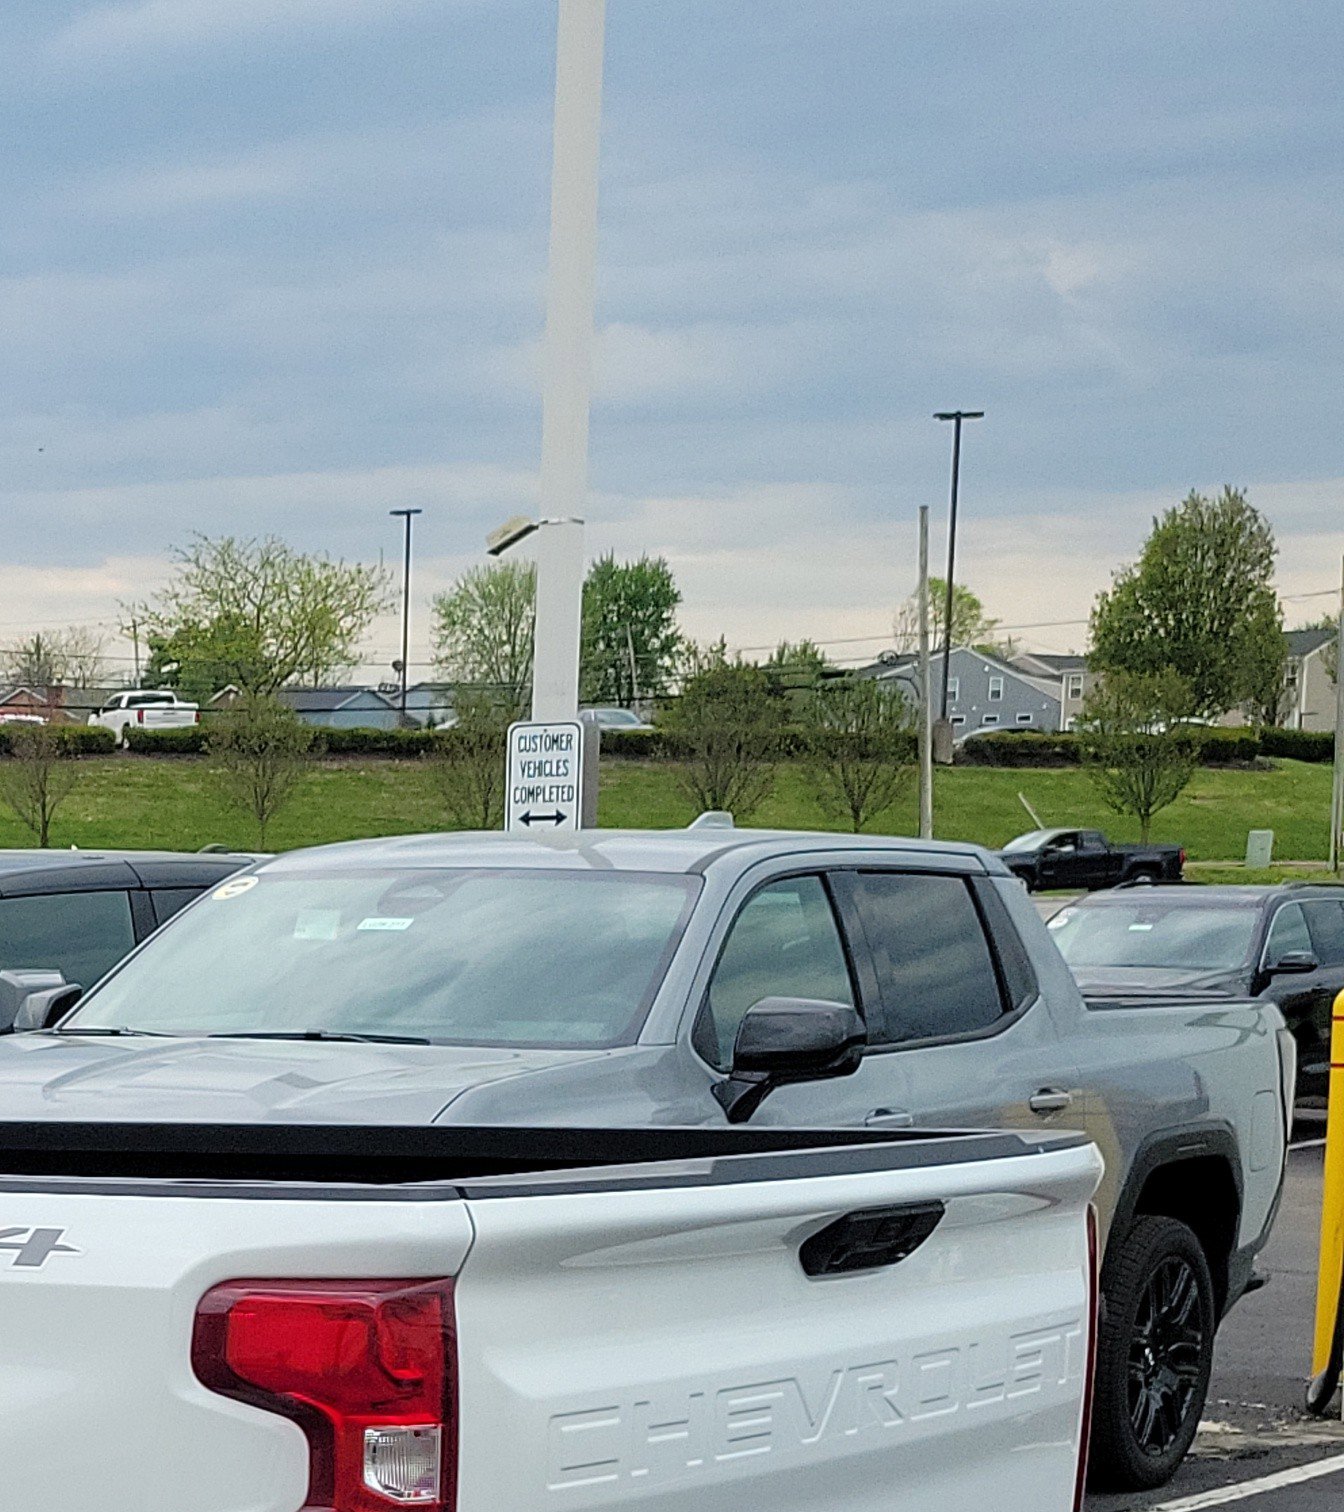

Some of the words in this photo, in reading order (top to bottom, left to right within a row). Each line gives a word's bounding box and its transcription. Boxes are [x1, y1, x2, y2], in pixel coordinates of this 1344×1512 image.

[518, 734, 573, 753] CUSTOMER
[520, 759, 569, 778] VEHICLES
[514, 785, 574, 804] COMPLETED
[547, 1319, 1082, 1490] CHEVROLET
